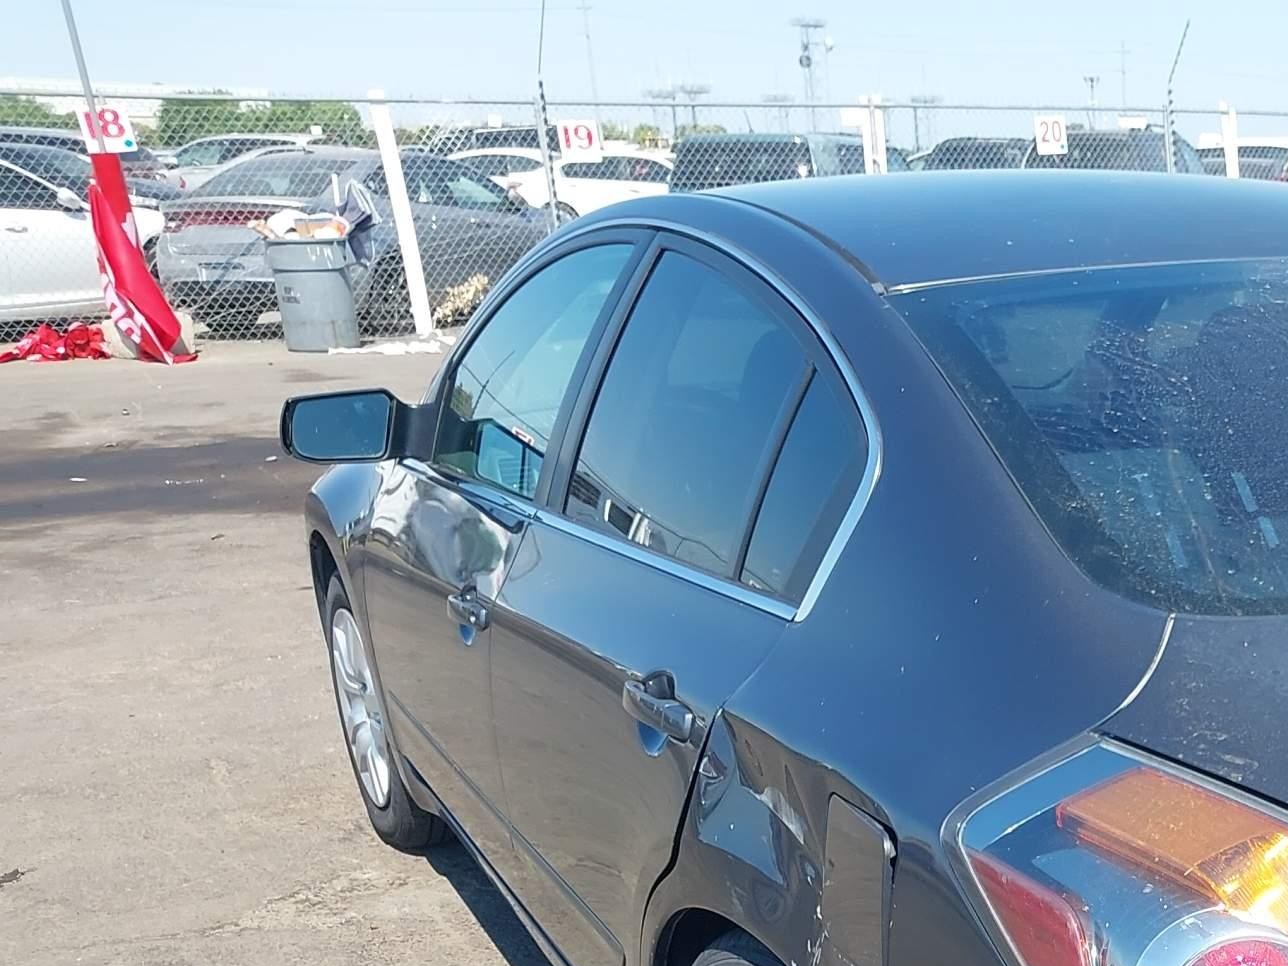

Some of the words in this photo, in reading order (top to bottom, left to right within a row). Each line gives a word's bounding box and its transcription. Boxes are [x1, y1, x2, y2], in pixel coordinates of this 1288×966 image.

[84, 109, 125, 139] 18
[1040, 120, 1062, 143] 20
[563, 125, 593, 150] 19
